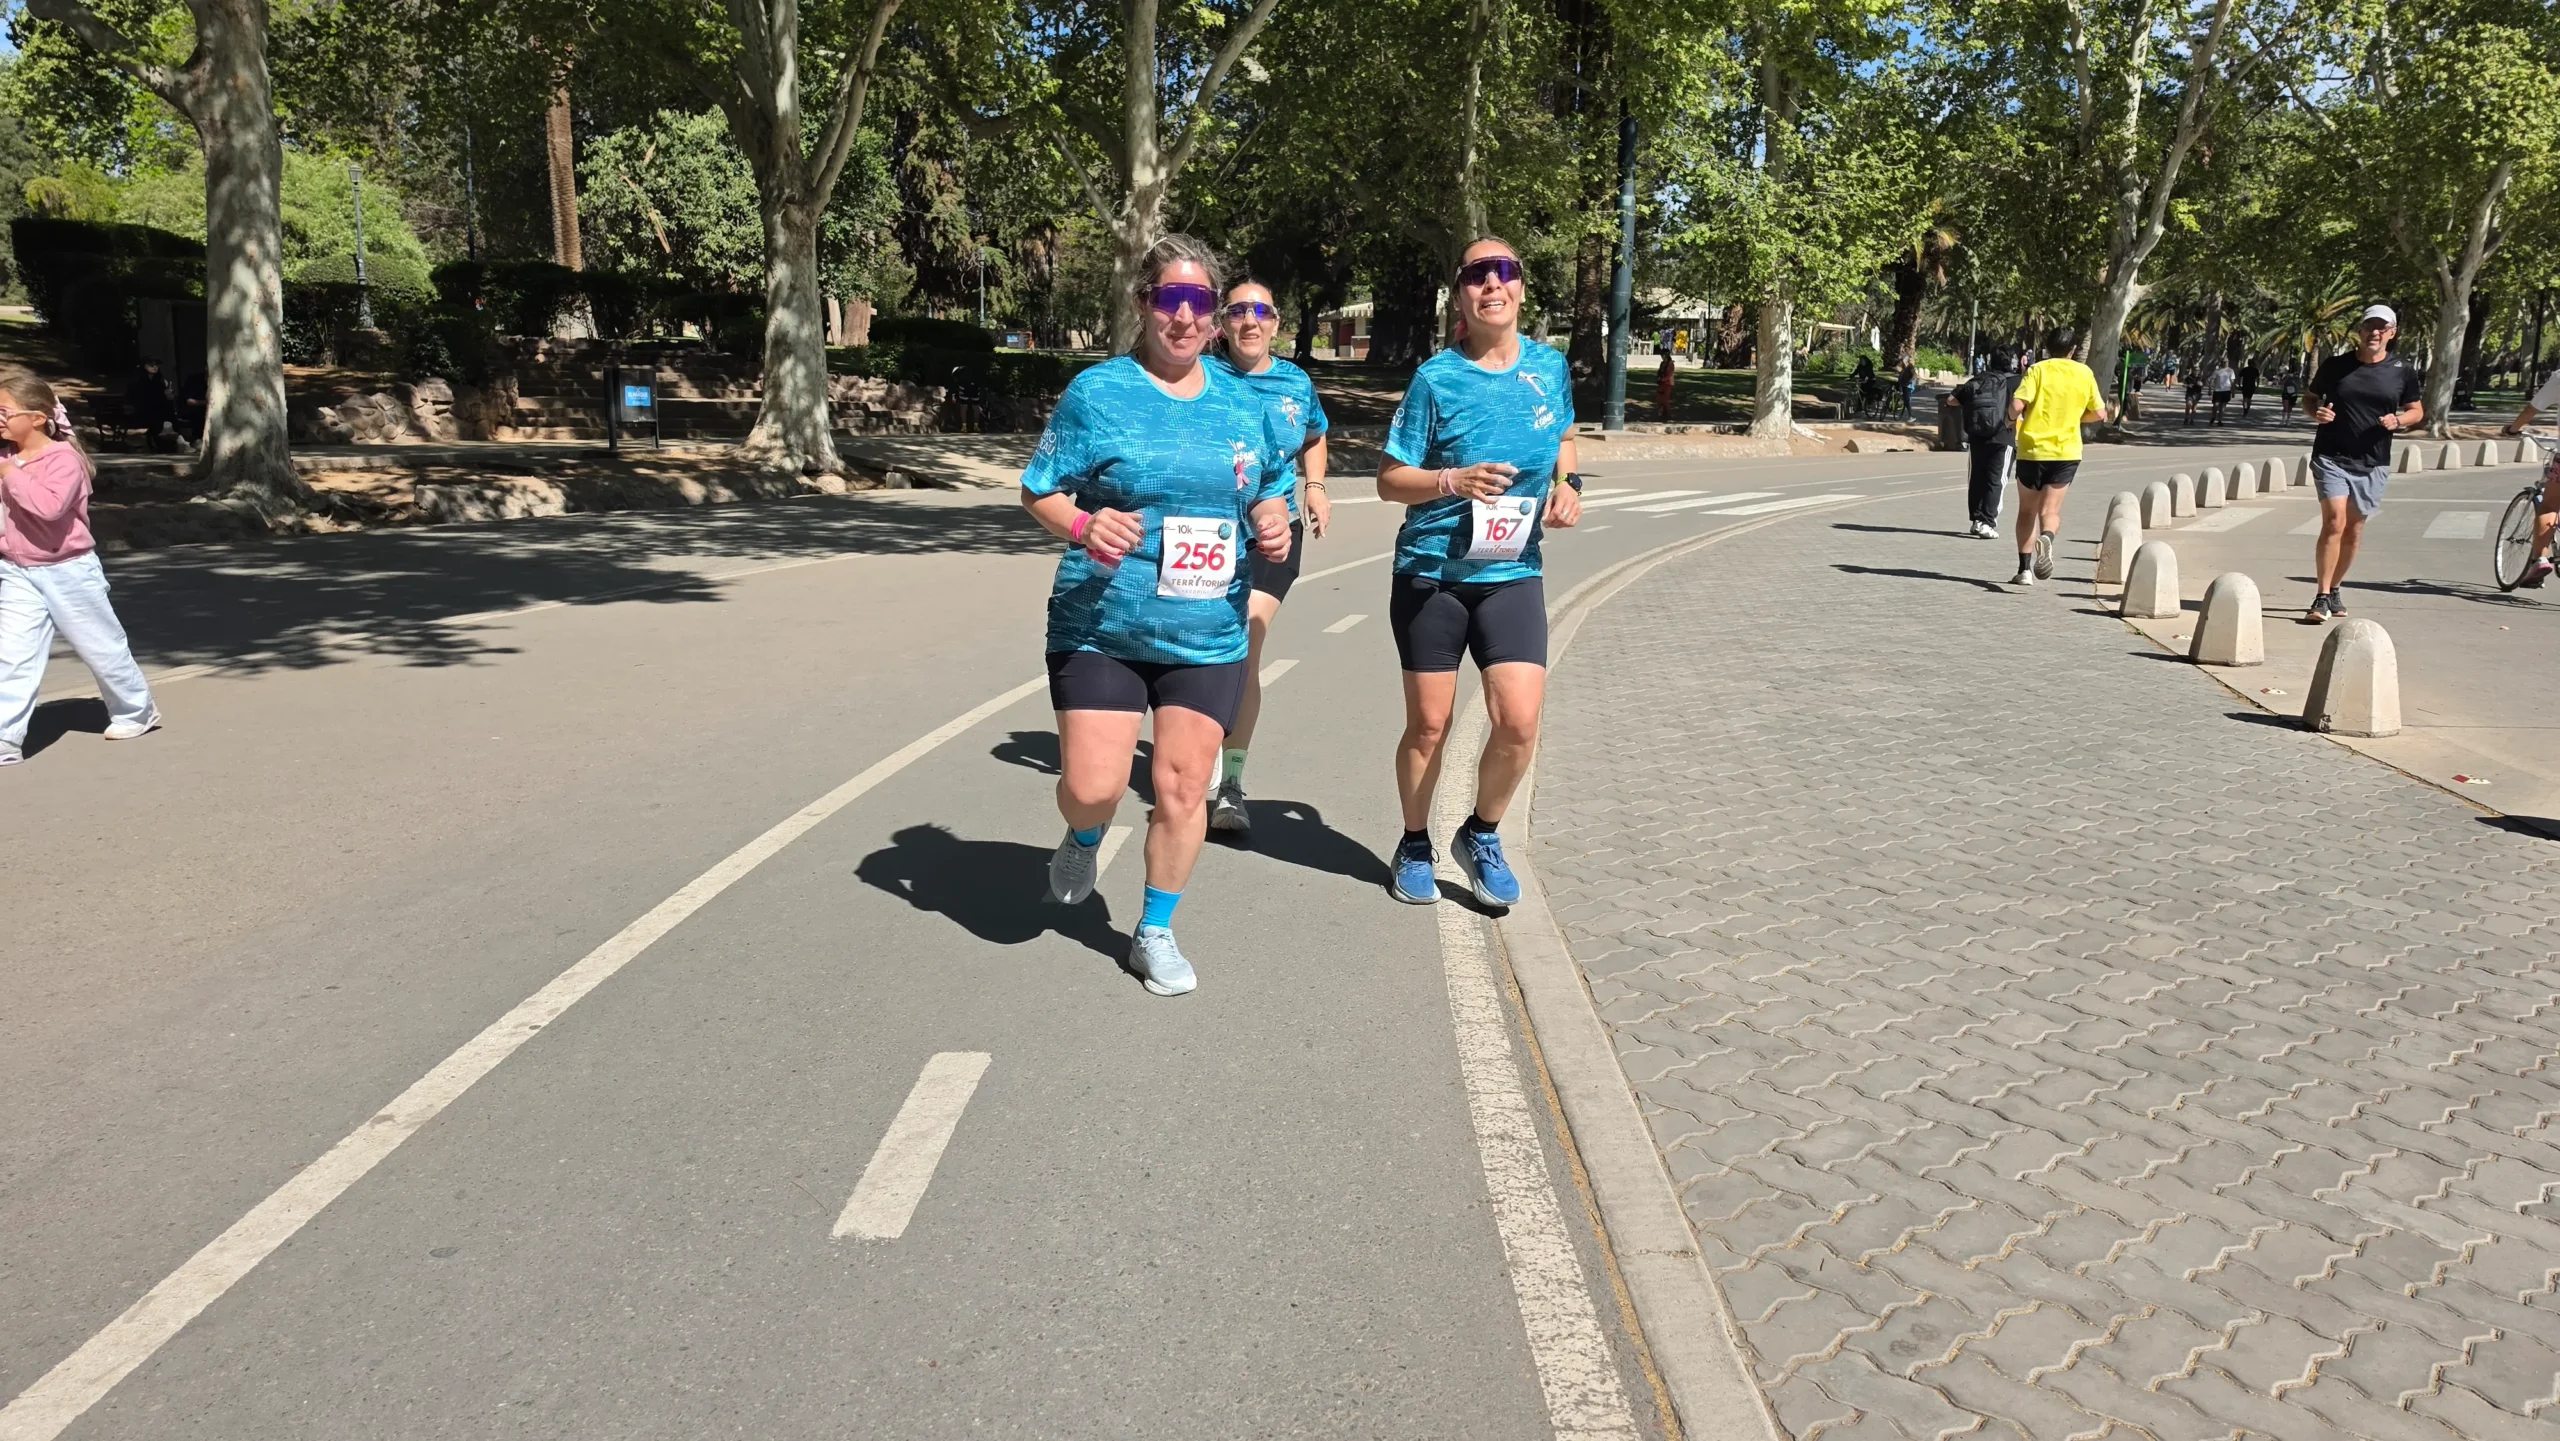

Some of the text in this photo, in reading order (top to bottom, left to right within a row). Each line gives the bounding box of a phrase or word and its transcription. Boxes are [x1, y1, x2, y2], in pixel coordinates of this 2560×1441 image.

[1177, 524, 1193, 535] 10k
[1485, 517, 1524, 541] 167
[1170, 541, 1227, 571] 256
